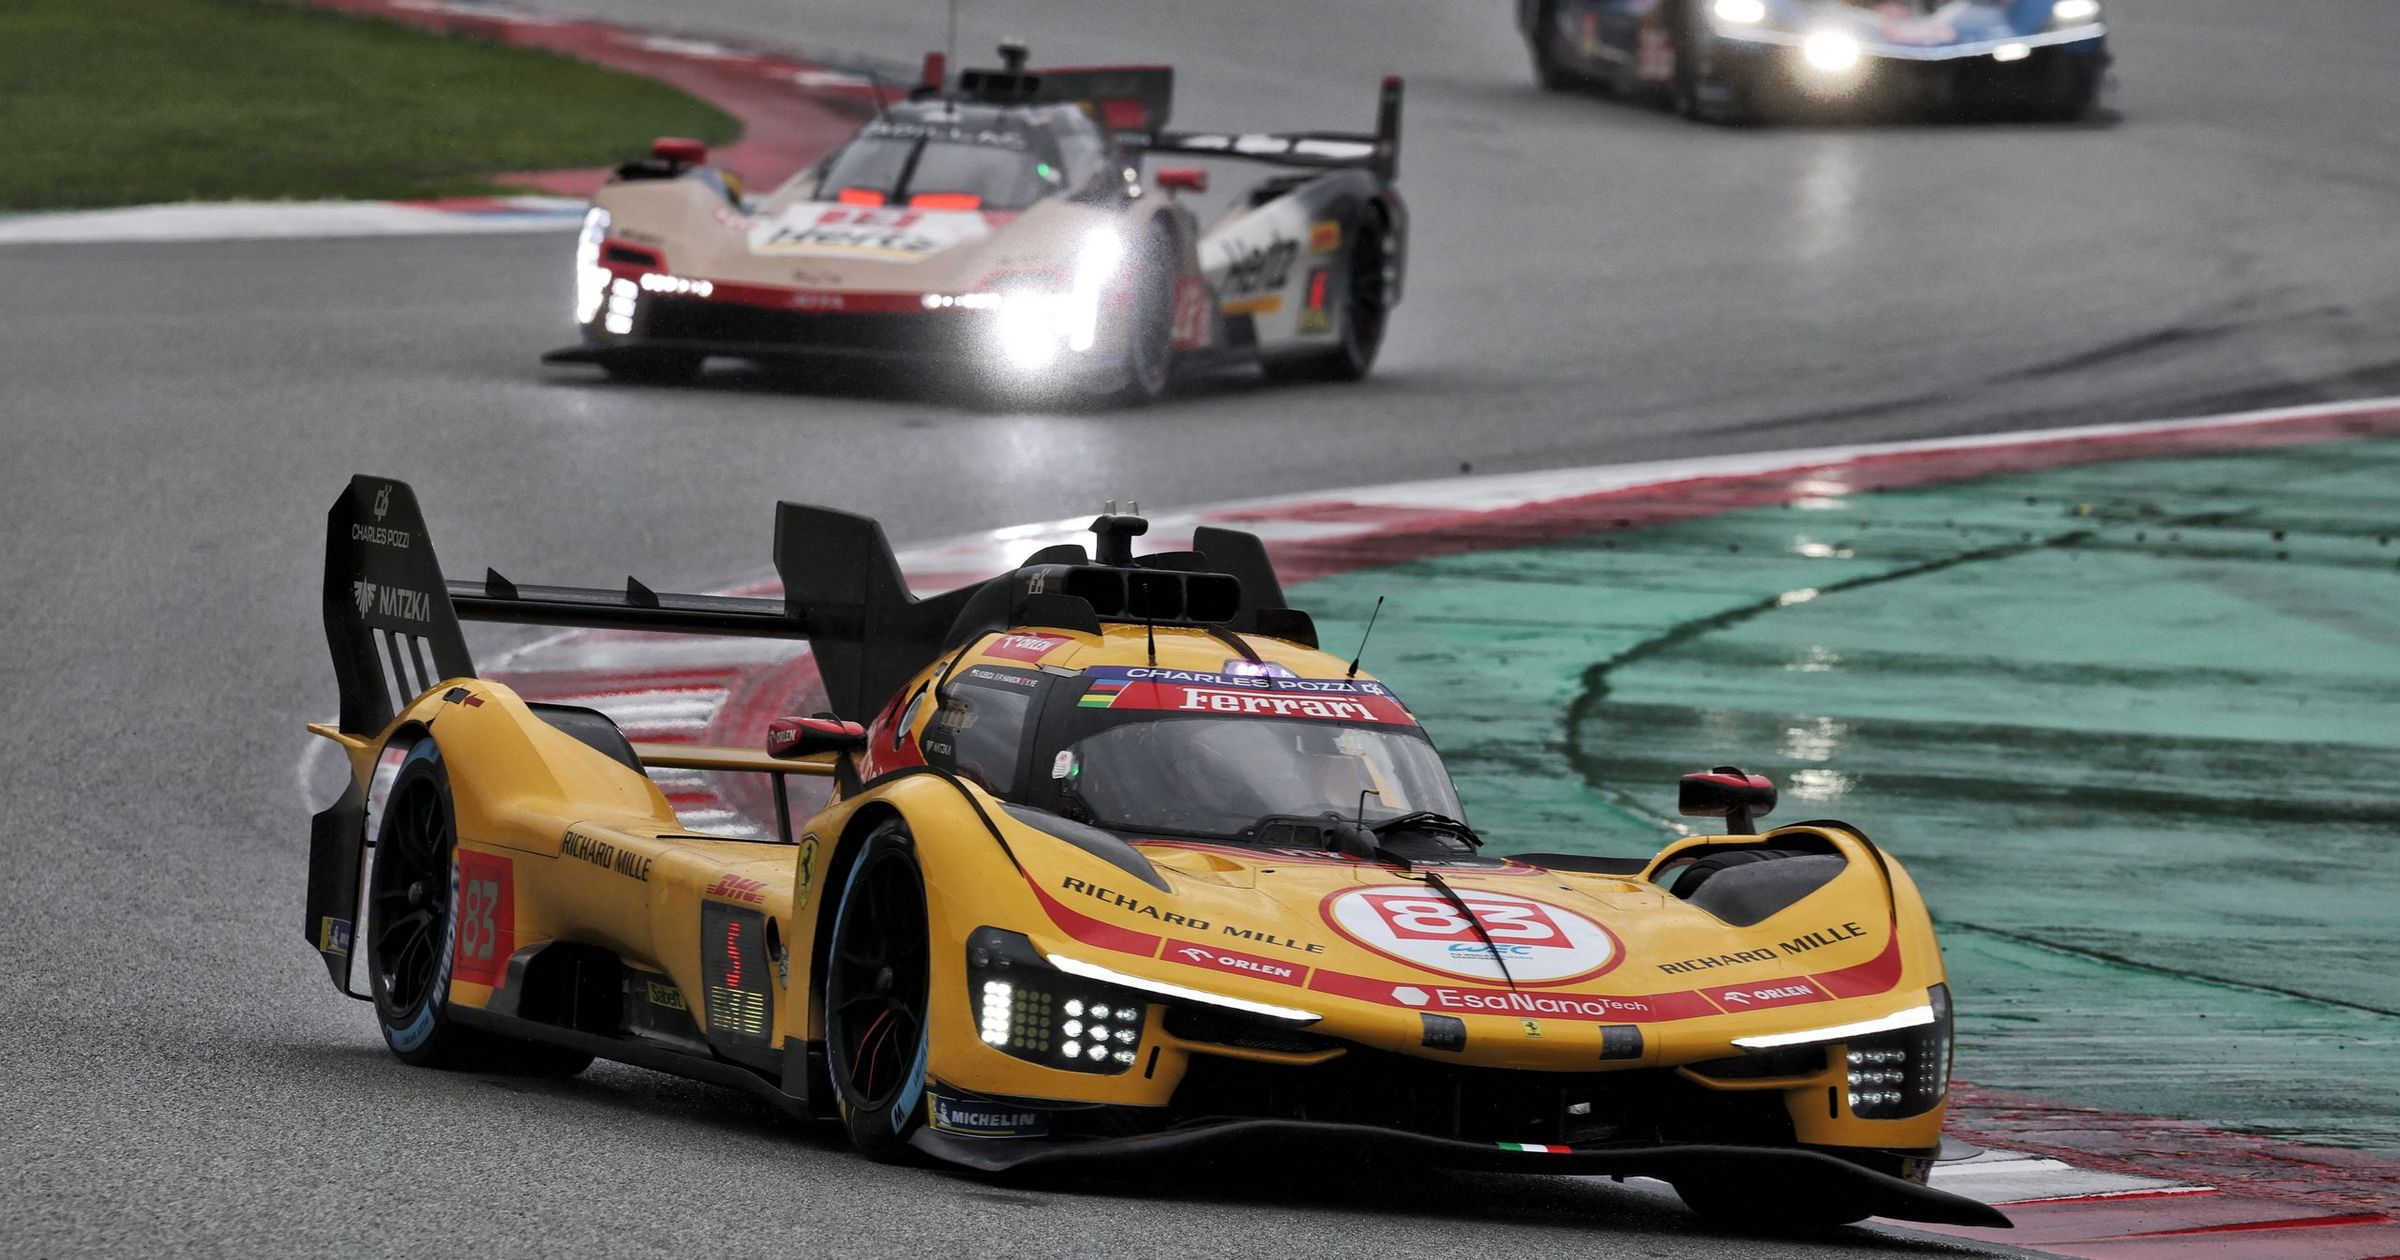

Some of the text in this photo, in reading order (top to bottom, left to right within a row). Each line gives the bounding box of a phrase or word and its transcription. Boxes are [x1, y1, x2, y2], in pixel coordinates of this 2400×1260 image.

[352, 523, 410, 548] CHARLES POZZI
[379, 585, 430, 622] NATZKA
[1126, 668, 1357, 692] CHARLES POZZI
[1179, 687, 1379, 721] Ferrari
[561, 830, 652, 882] RICHARD MILLE
[712, 873, 768, 903] DHL
[462, 879, 498, 961] 83
[1062, 876, 1326, 954] RICHARD MILLE
[1383, 900, 1555, 940] 83
[1448, 943, 1532, 955] WEC
[1658, 922, 1867, 975] RICHARD MILLE
[1218, 957, 1293, 978] ORLEN
[1753, 984, 1814, 1001] ORLEN
[952, 1110, 1036, 1127] MICHELIN
